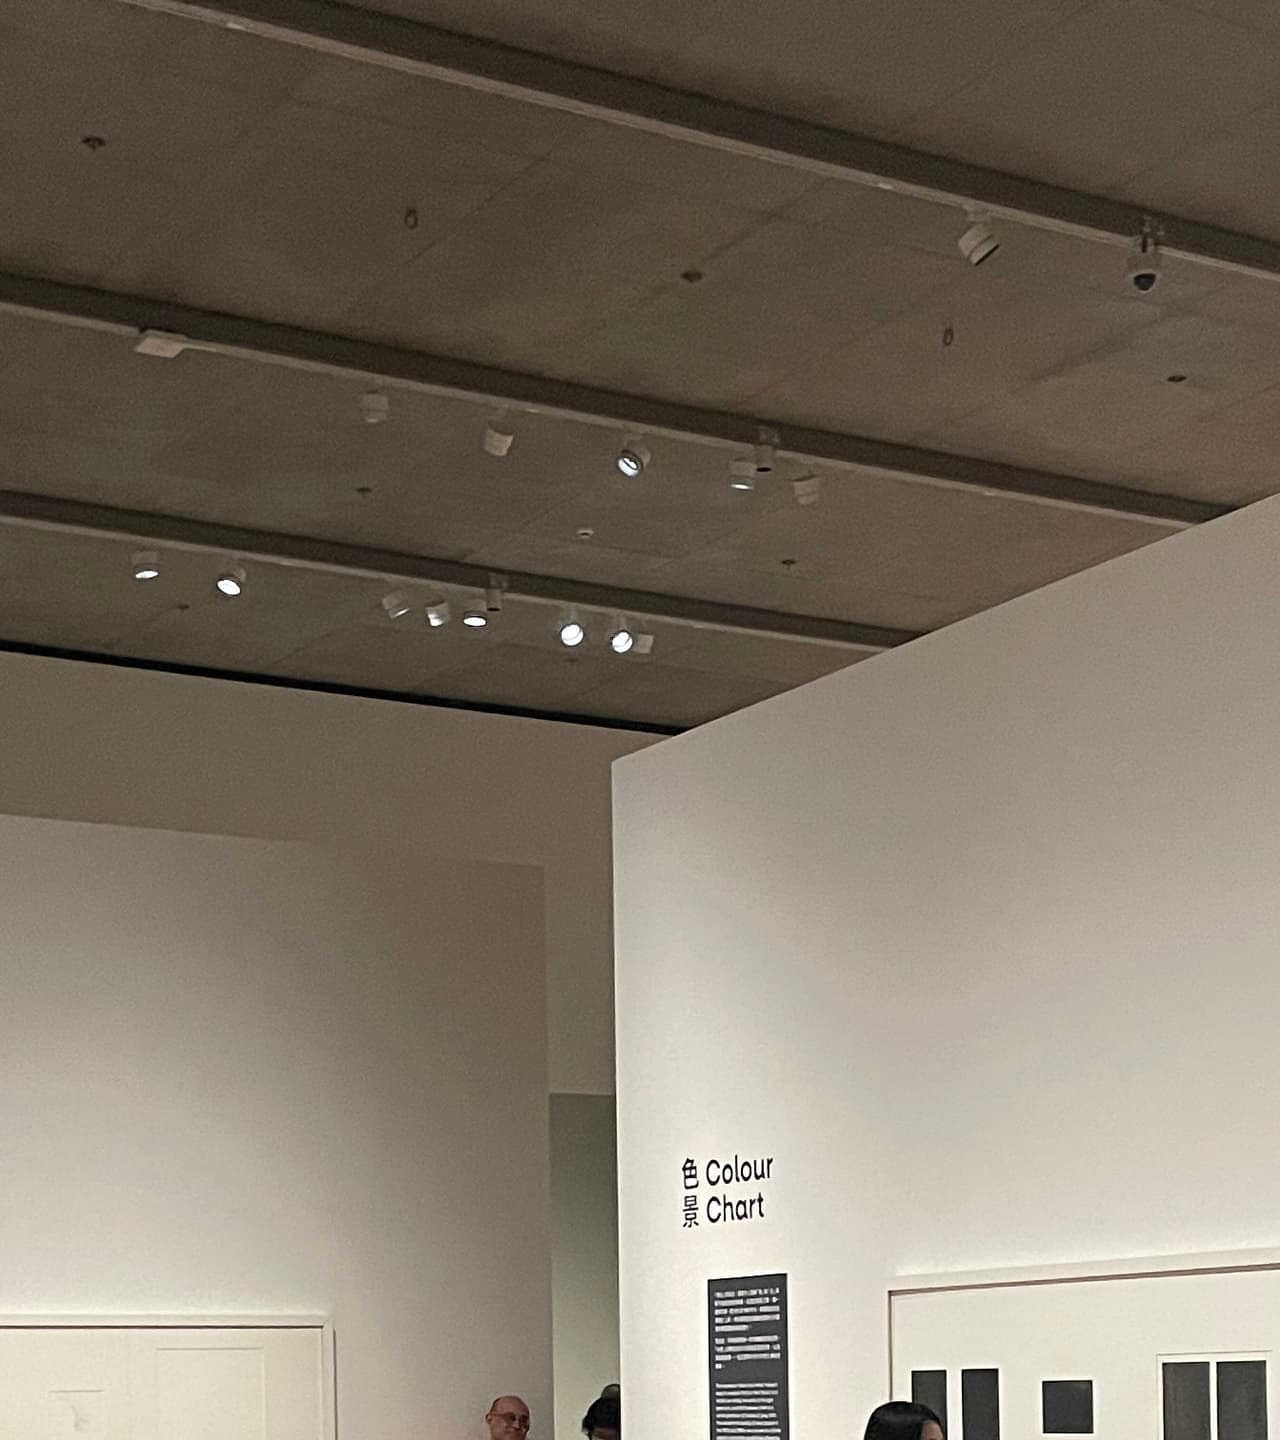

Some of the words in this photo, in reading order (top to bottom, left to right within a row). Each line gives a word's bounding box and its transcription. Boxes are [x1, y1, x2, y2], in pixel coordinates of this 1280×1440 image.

[706, 1154, 773, 1186] Colour
[681, 1158, 700, 1228] 色景
[707, 1192, 764, 1223] Chart
